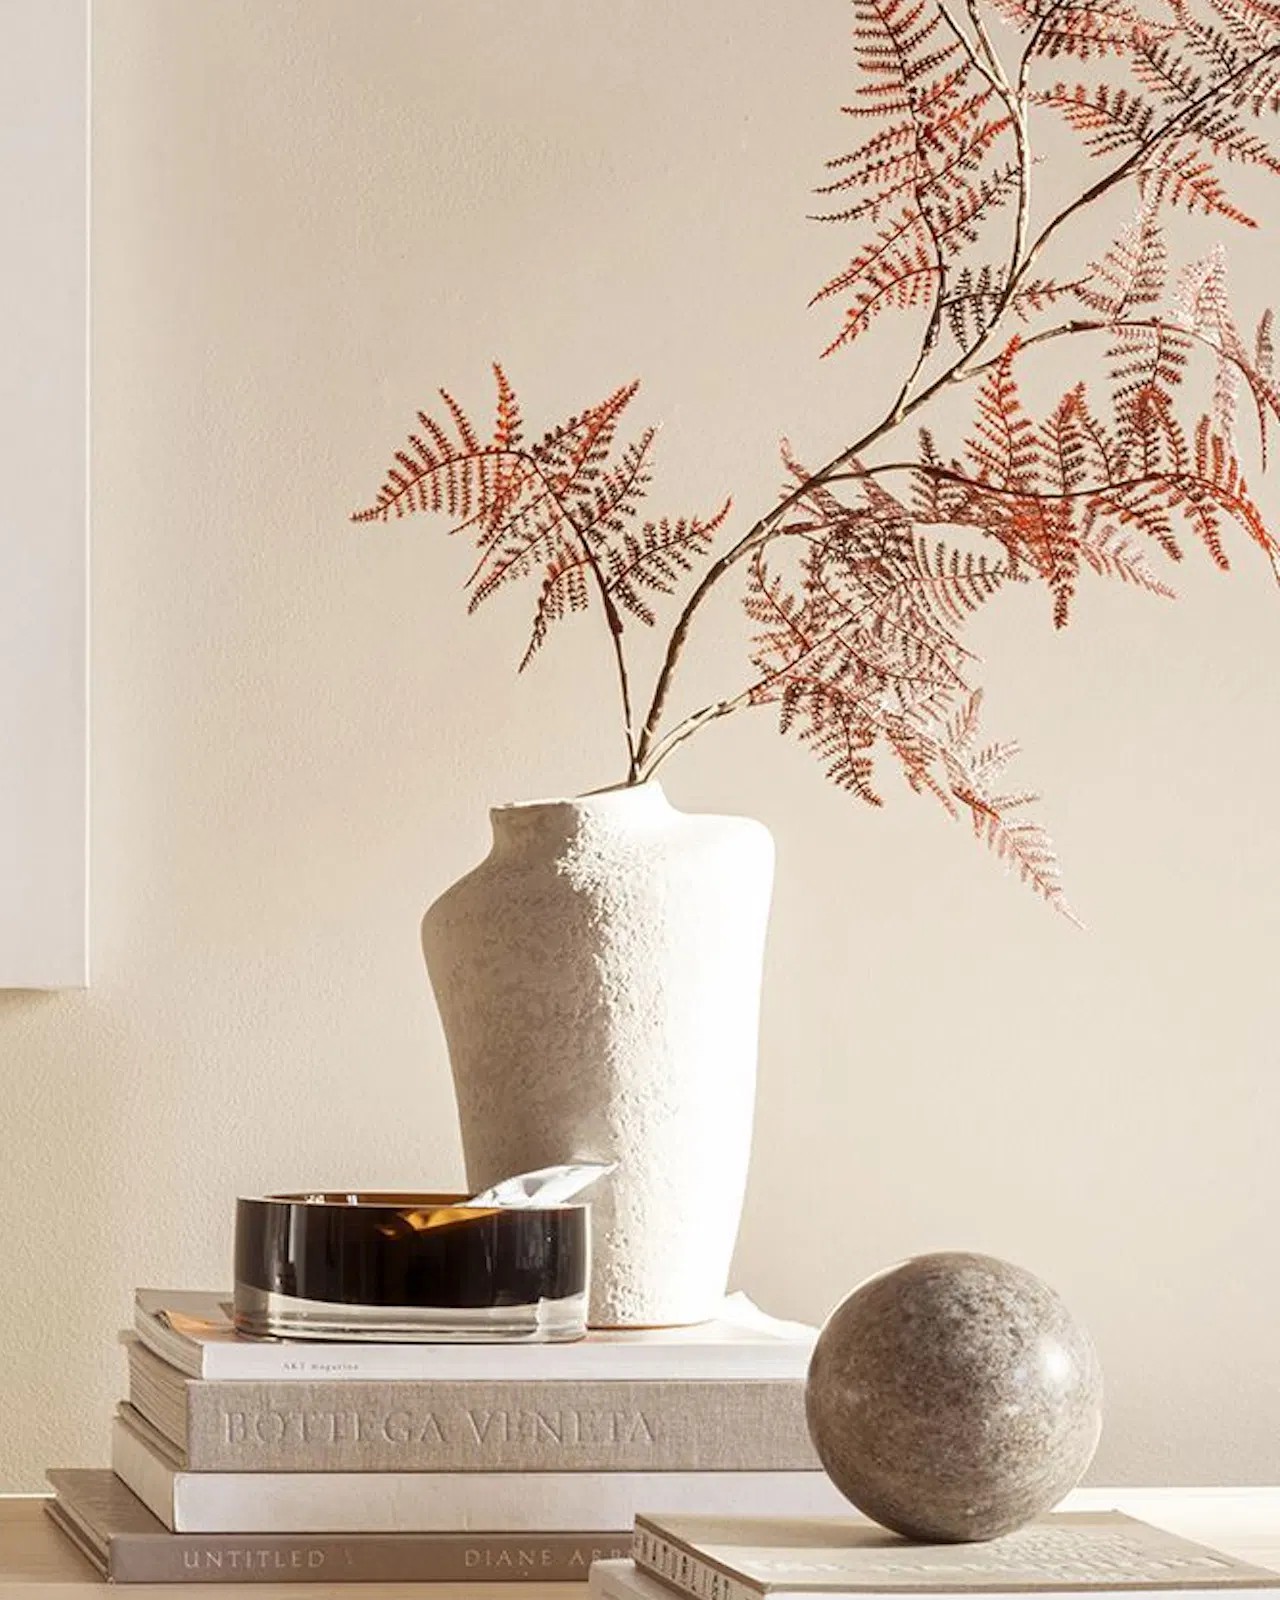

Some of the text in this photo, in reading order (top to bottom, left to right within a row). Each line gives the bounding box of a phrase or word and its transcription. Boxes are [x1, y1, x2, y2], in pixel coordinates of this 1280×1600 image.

[221, 1410, 658, 1446] BOTTEGA VENETA
[183, 1549, 326, 1568] UNTITLED
[464, 1549, 553, 1568] DIANE
